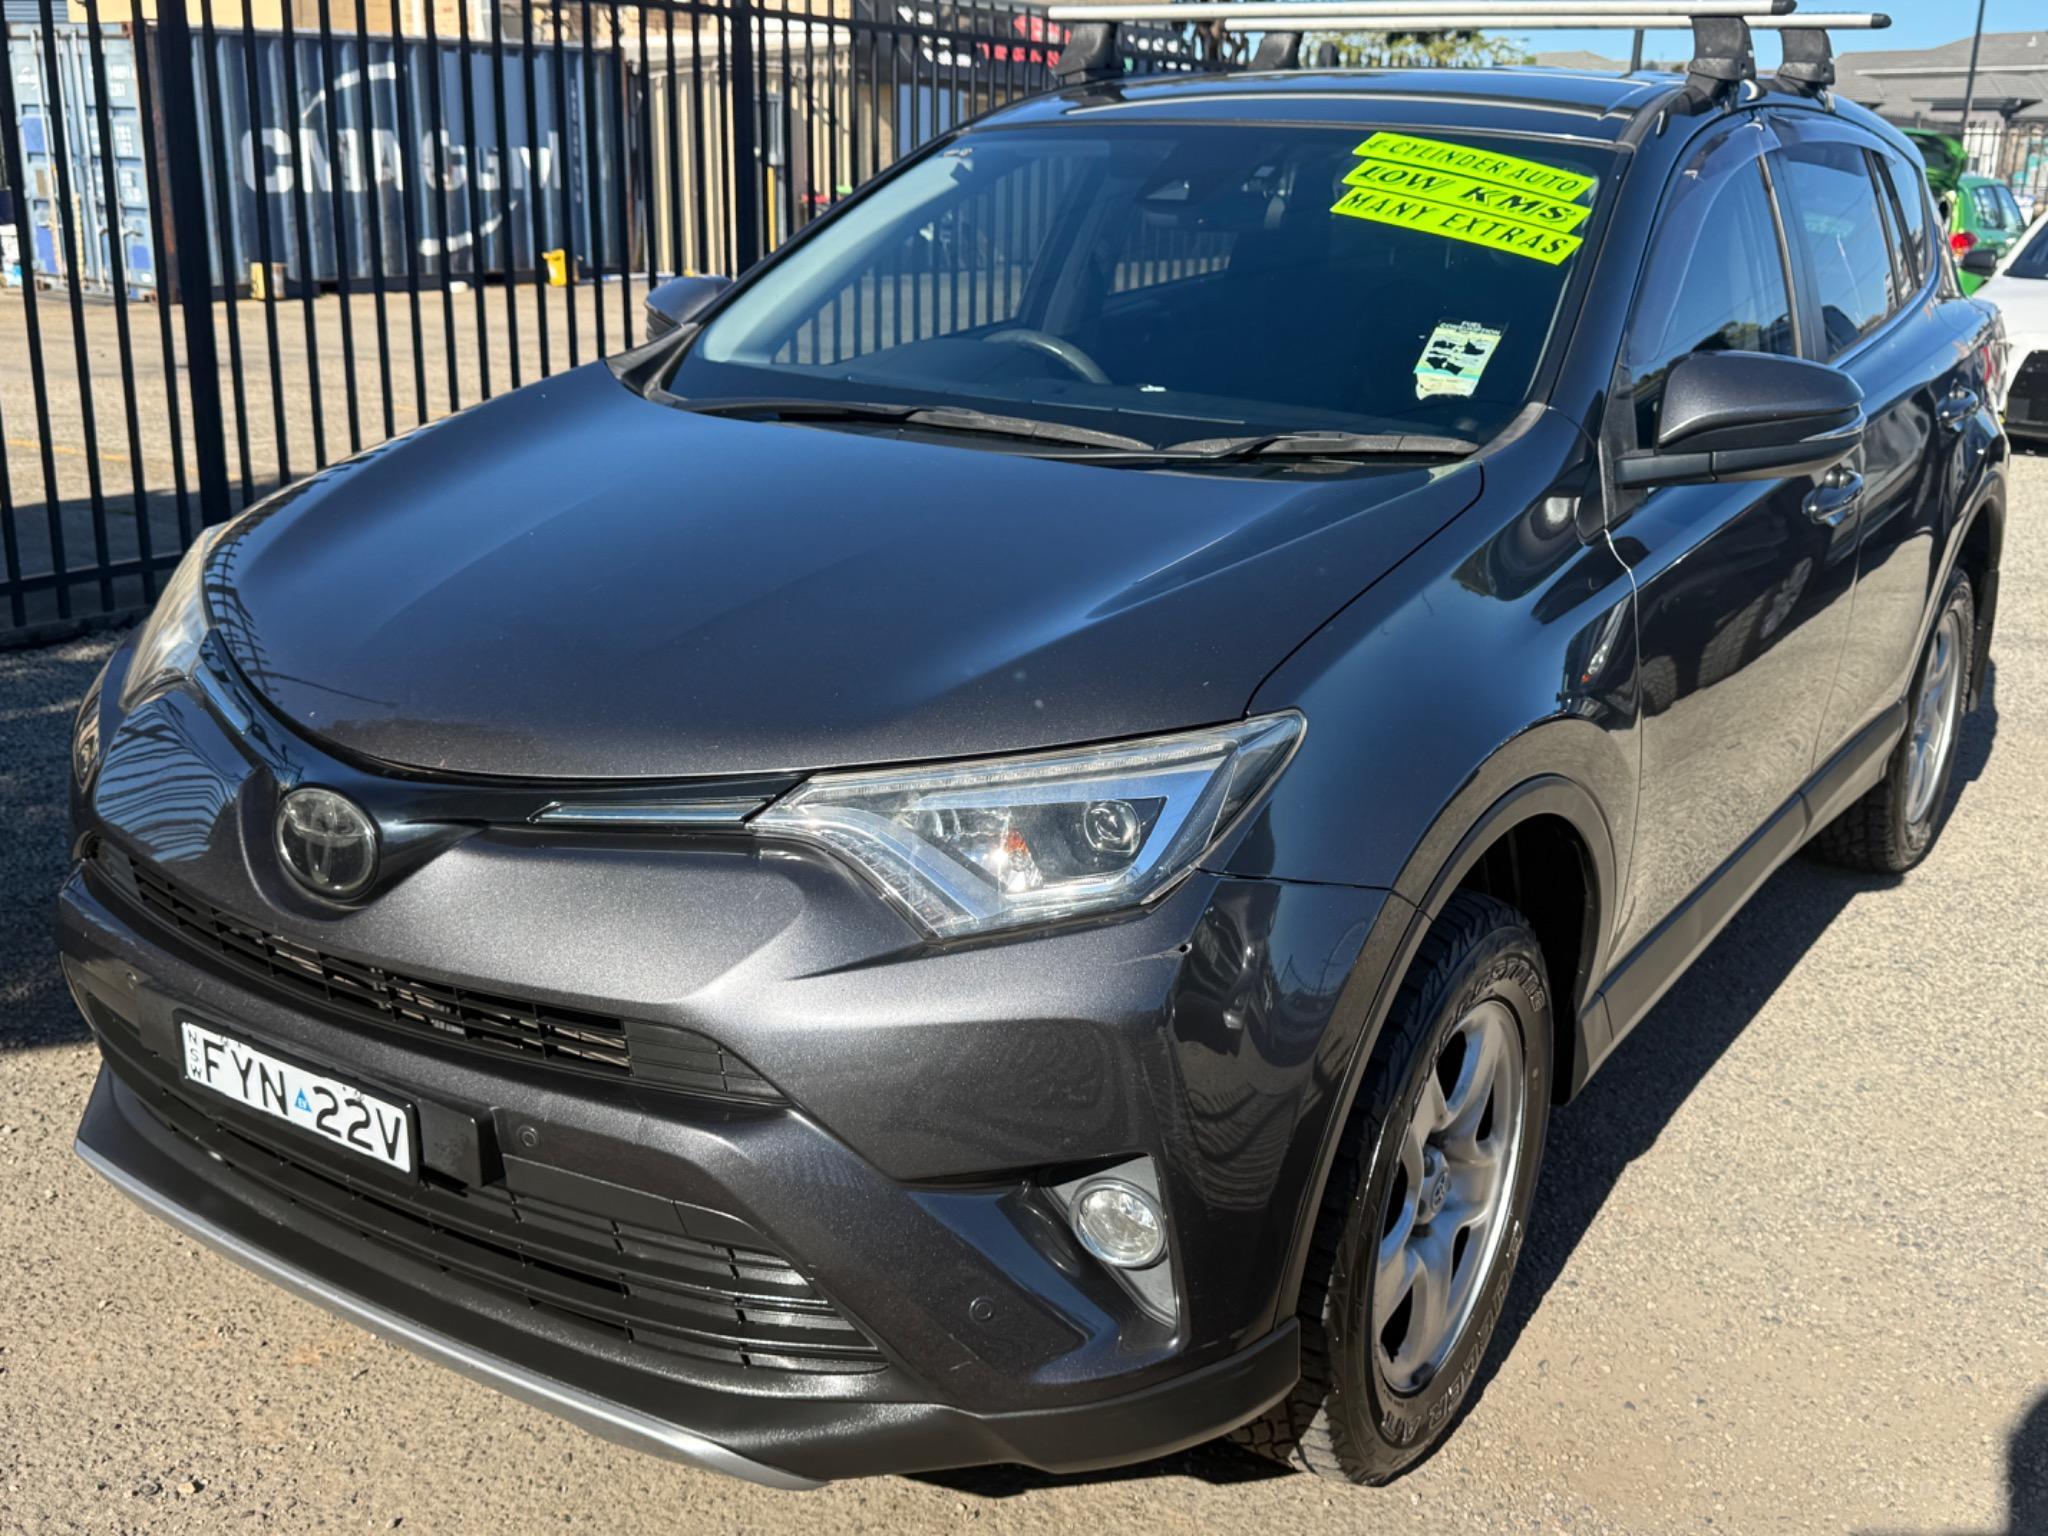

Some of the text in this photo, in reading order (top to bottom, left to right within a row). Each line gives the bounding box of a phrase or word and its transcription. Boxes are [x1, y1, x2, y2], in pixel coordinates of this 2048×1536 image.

[1355, 165, 1577, 224] LOW KMS
[1504, 168, 1580, 193] AUTO
[1340, 193, 1569, 254] MANY EXTRAS
[203, 1038, 401, 1161] FYN 22V
